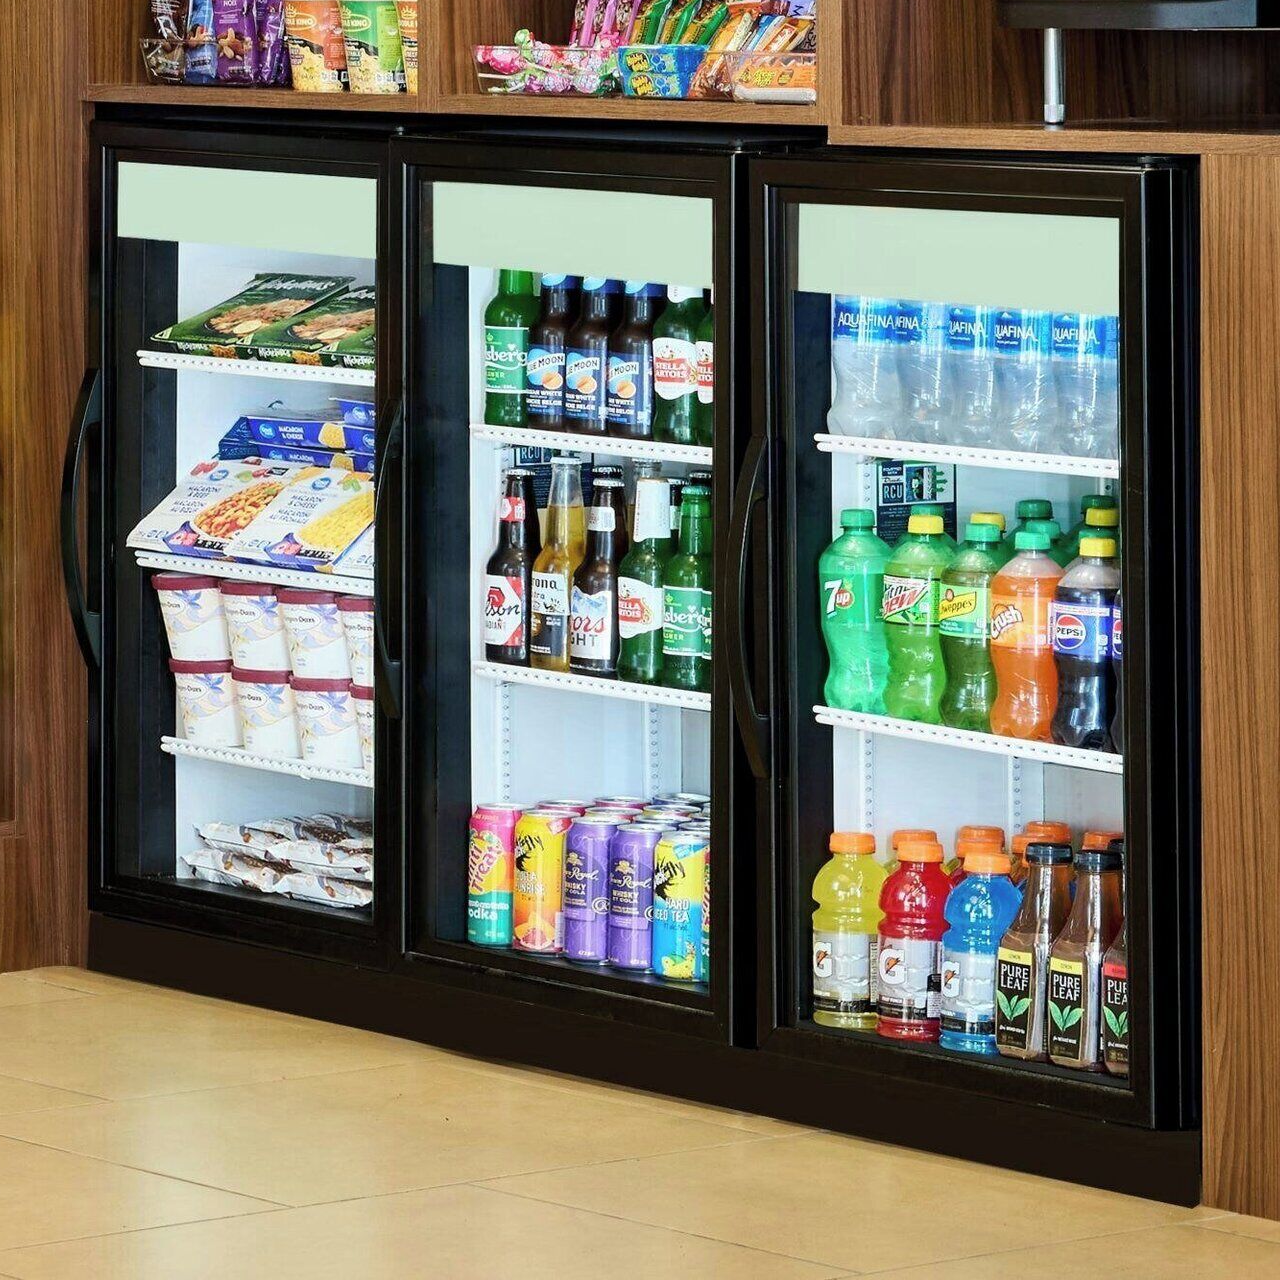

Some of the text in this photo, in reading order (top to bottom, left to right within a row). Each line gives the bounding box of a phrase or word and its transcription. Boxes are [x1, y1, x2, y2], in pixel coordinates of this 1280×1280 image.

[838, 311, 894, 329] AQUAFINA
[538, 355, 564, 366] MOON
[573, 359, 598, 370] MOON
[615, 364, 637, 373] MOON
[884, 485, 902, 498] RCU
[991, 605, 1023, 639] Crush
[1057, 627, 1083, 636] PEPSI
[469, 908, 498, 920] odka
[672, 911, 689, 922] TEA
[880, 948, 907, 985] G
[1001, 964, 1029, 979] PURE
[1001, 975, 1029, 991] LEAF
[1053, 974, 1080, 989] PURE
[1108, 980, 1127, 993] PUR
[1053, 985, 1080, 1001] LEAF
[1108, 992, 1127, 1005] LEA
